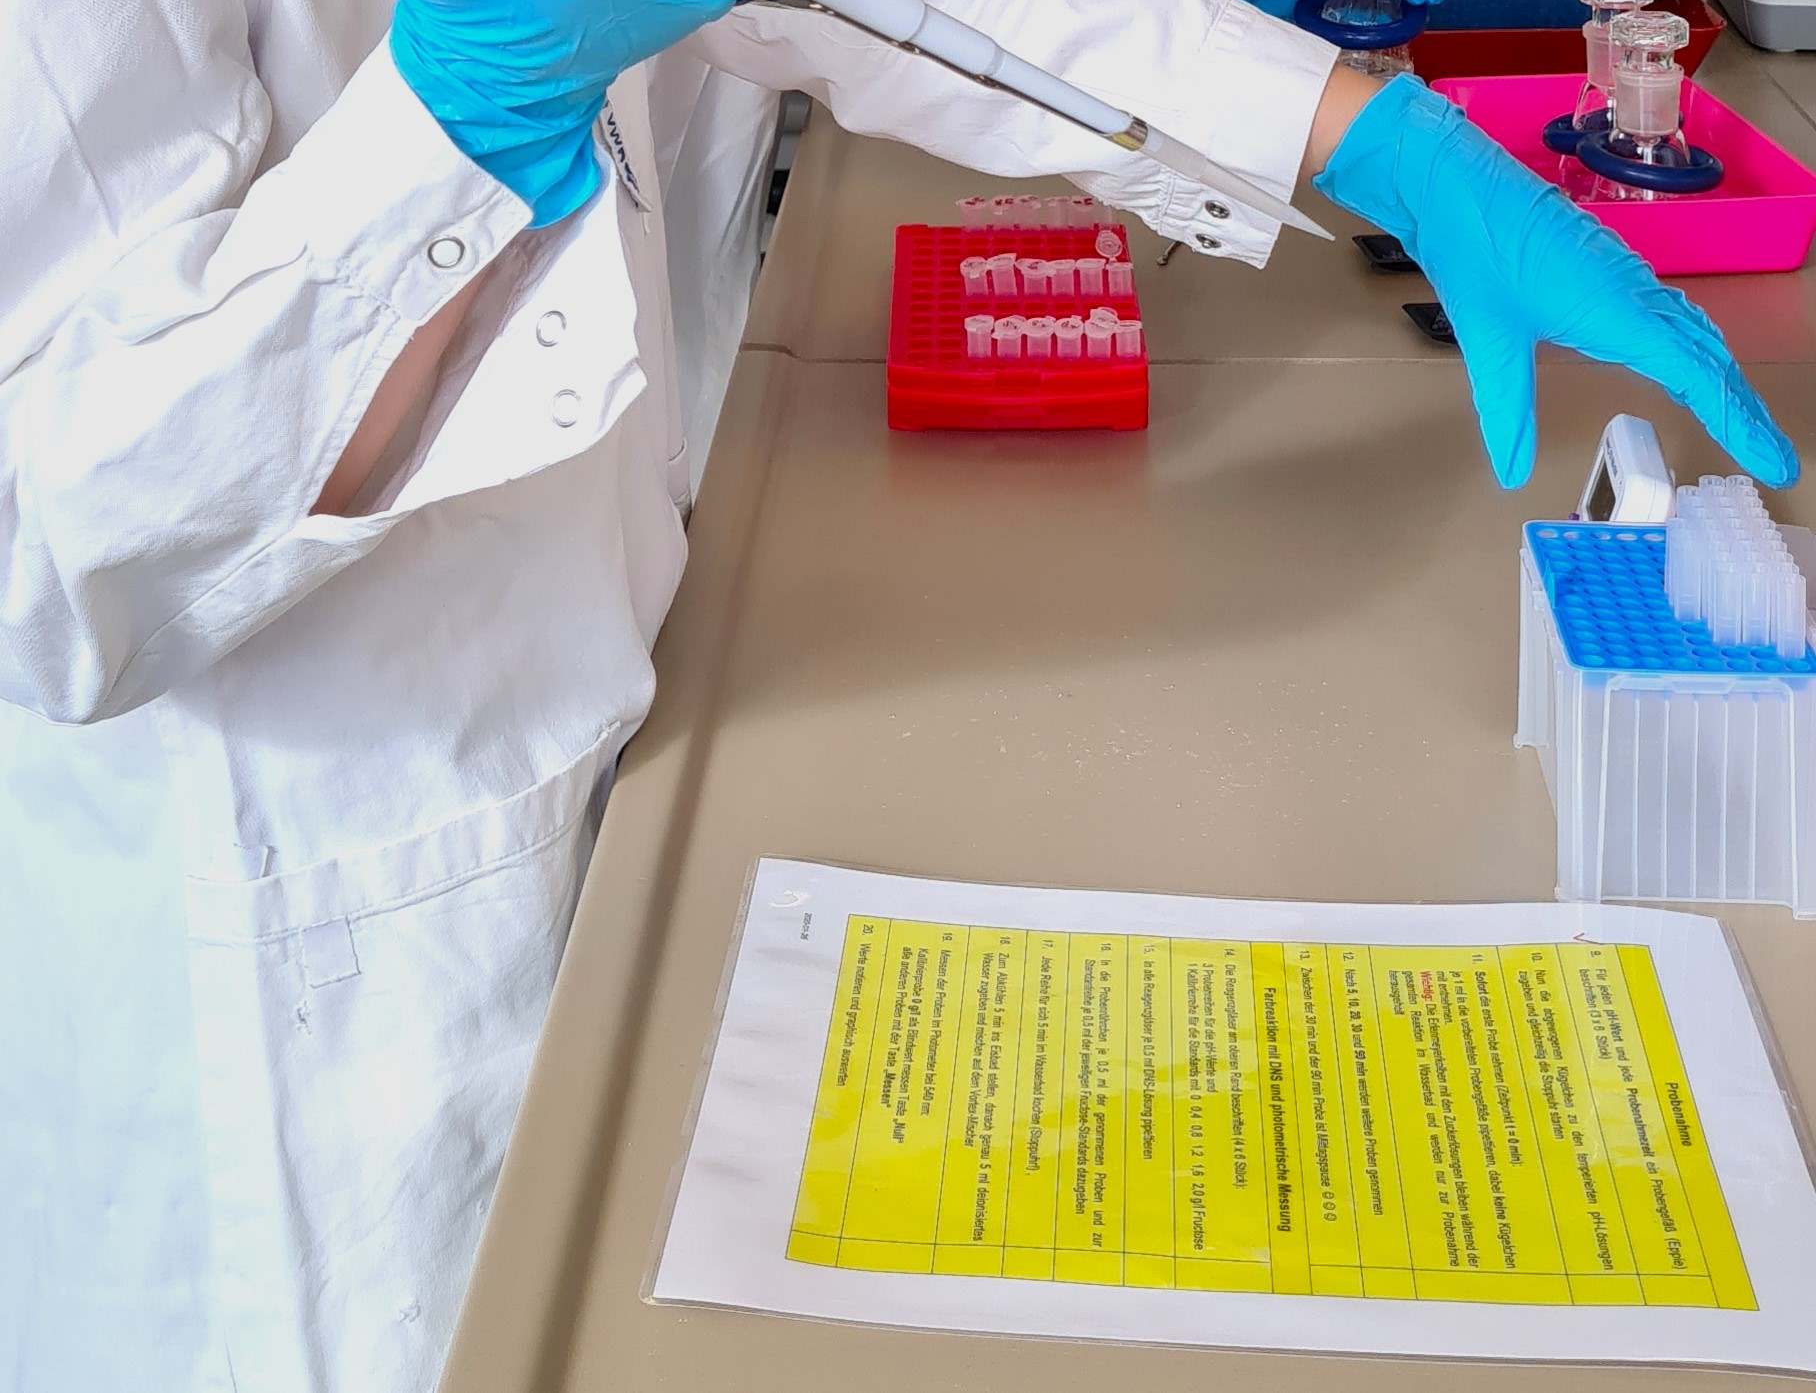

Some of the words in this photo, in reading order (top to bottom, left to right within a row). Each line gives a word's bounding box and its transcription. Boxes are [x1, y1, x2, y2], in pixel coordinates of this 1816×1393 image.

[1264, 987, 1279, 1043] Farbreaktion
[1268, 1044, 1281, 1059] mit
[1269, 1061, 1283, 1081] DNS
[1270, 1084, 1285, 1102] und
[1188, 1106, 1203, 1119] 0,4
[1665, 1082, 1692, 1147] Probenahme
[1190, 1145, 1204, 1157] 1,2
[1269, 1104, 1290, 1181] photometrische
[1191, 1183, 1205, 1197] 2,0
[1277, 1183, 1292, 1232] Messung
[1092, 1232, 1102, 1247] zur
[1193, 1210, 1206, 1250] Fructose
[1442, 1211, 1460, 1267] Probenahme
[1587, 1211, 1614, 1270] pH-Lösungen
